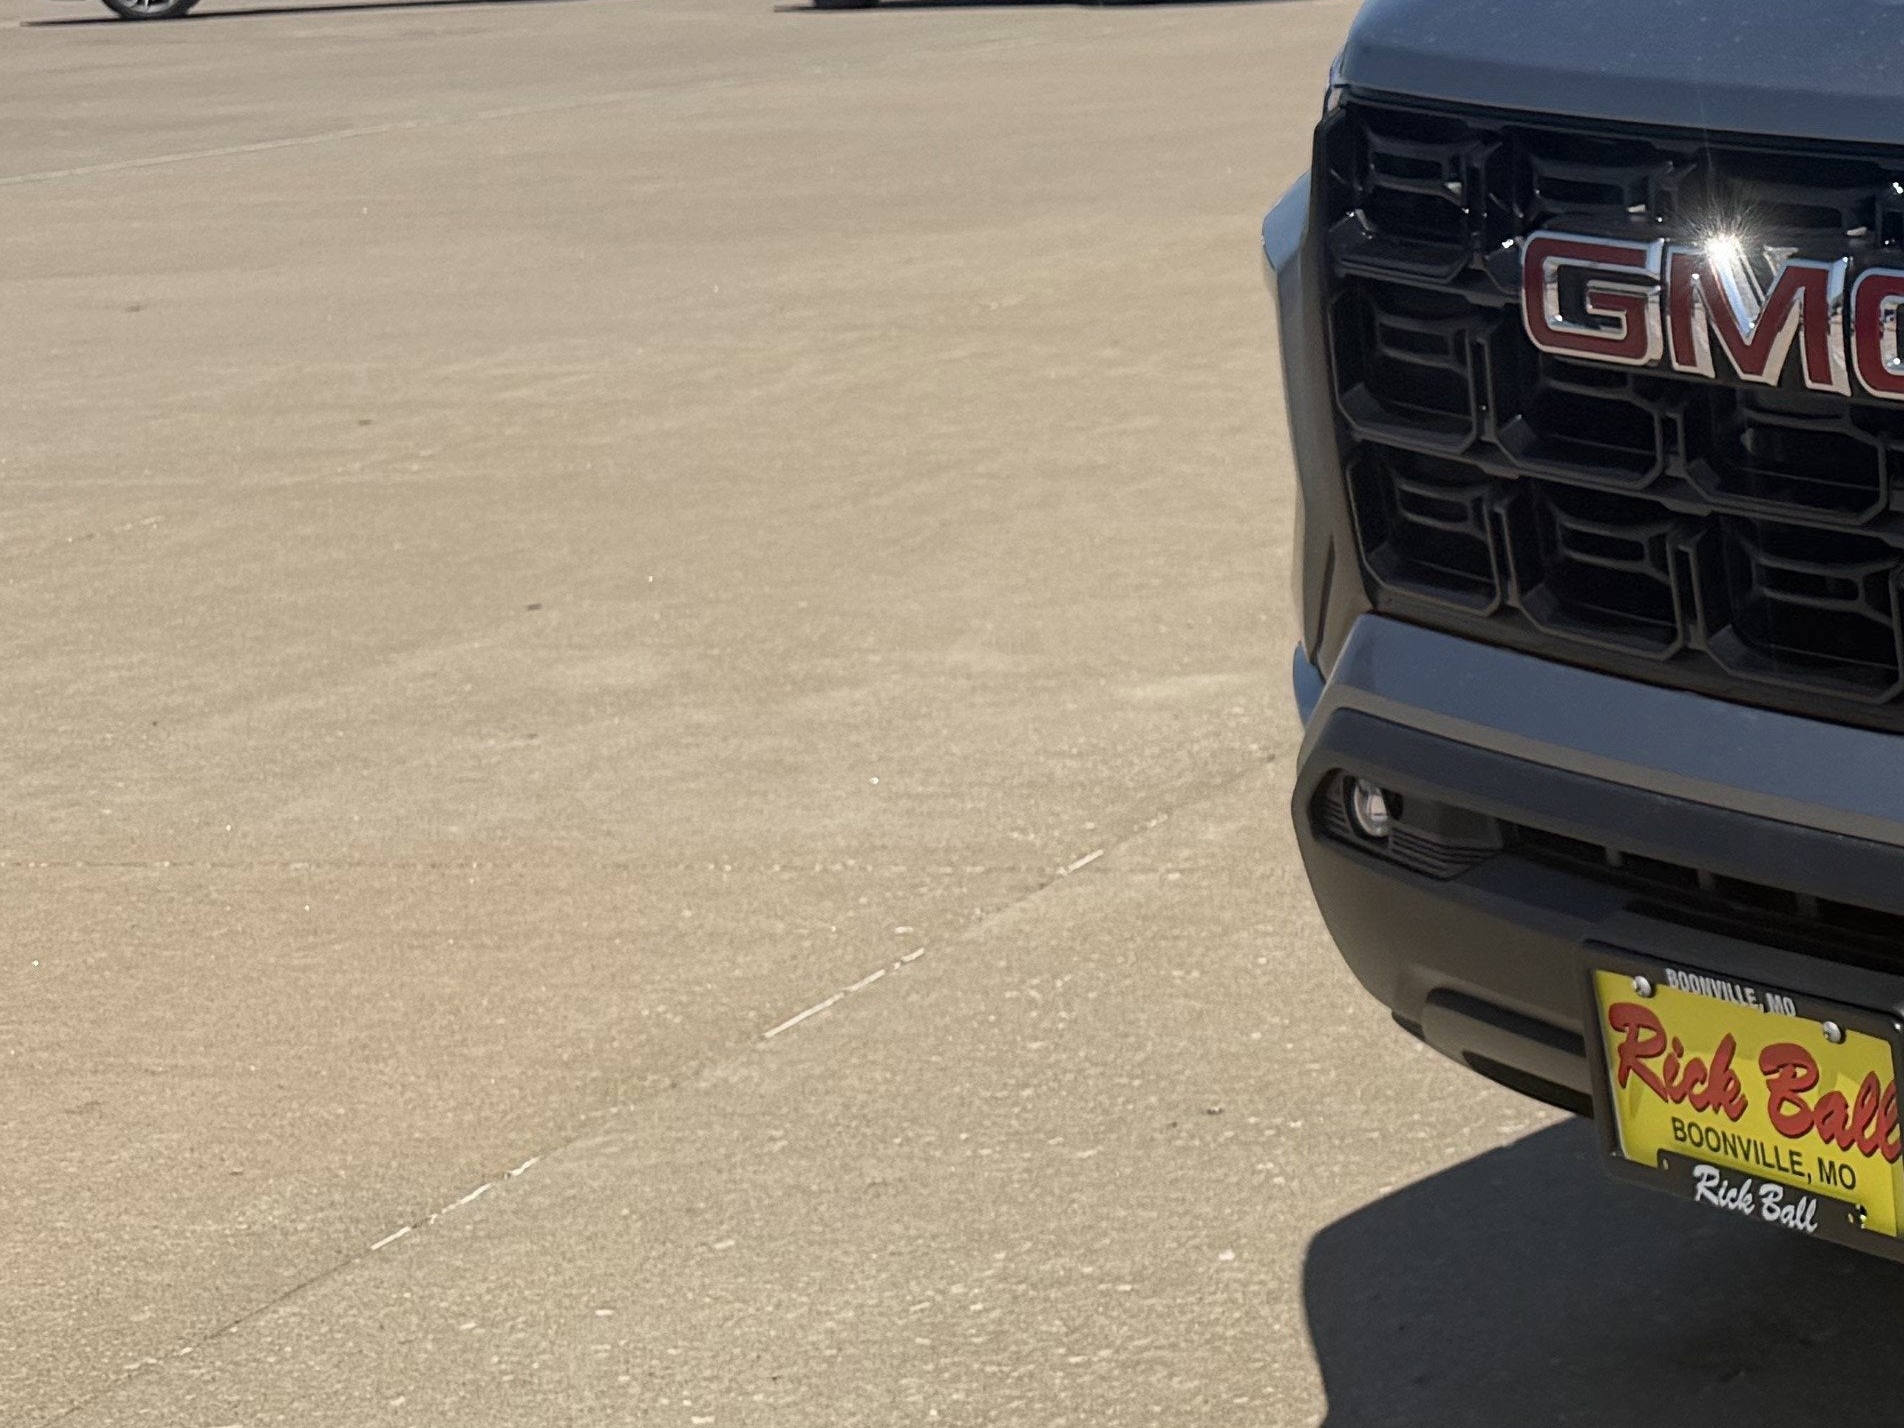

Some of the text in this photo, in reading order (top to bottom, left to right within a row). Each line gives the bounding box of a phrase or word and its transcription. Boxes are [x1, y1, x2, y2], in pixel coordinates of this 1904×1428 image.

[1666, 968, 1797, 1018] BOONVILLE, MO
[1608, 1002, 1902, 1163] Rick Ball
[1672, 1117, 1857, 1190] BOONVILLE, MO
[1693, 1164, 1818, 1233] Rick Ball
